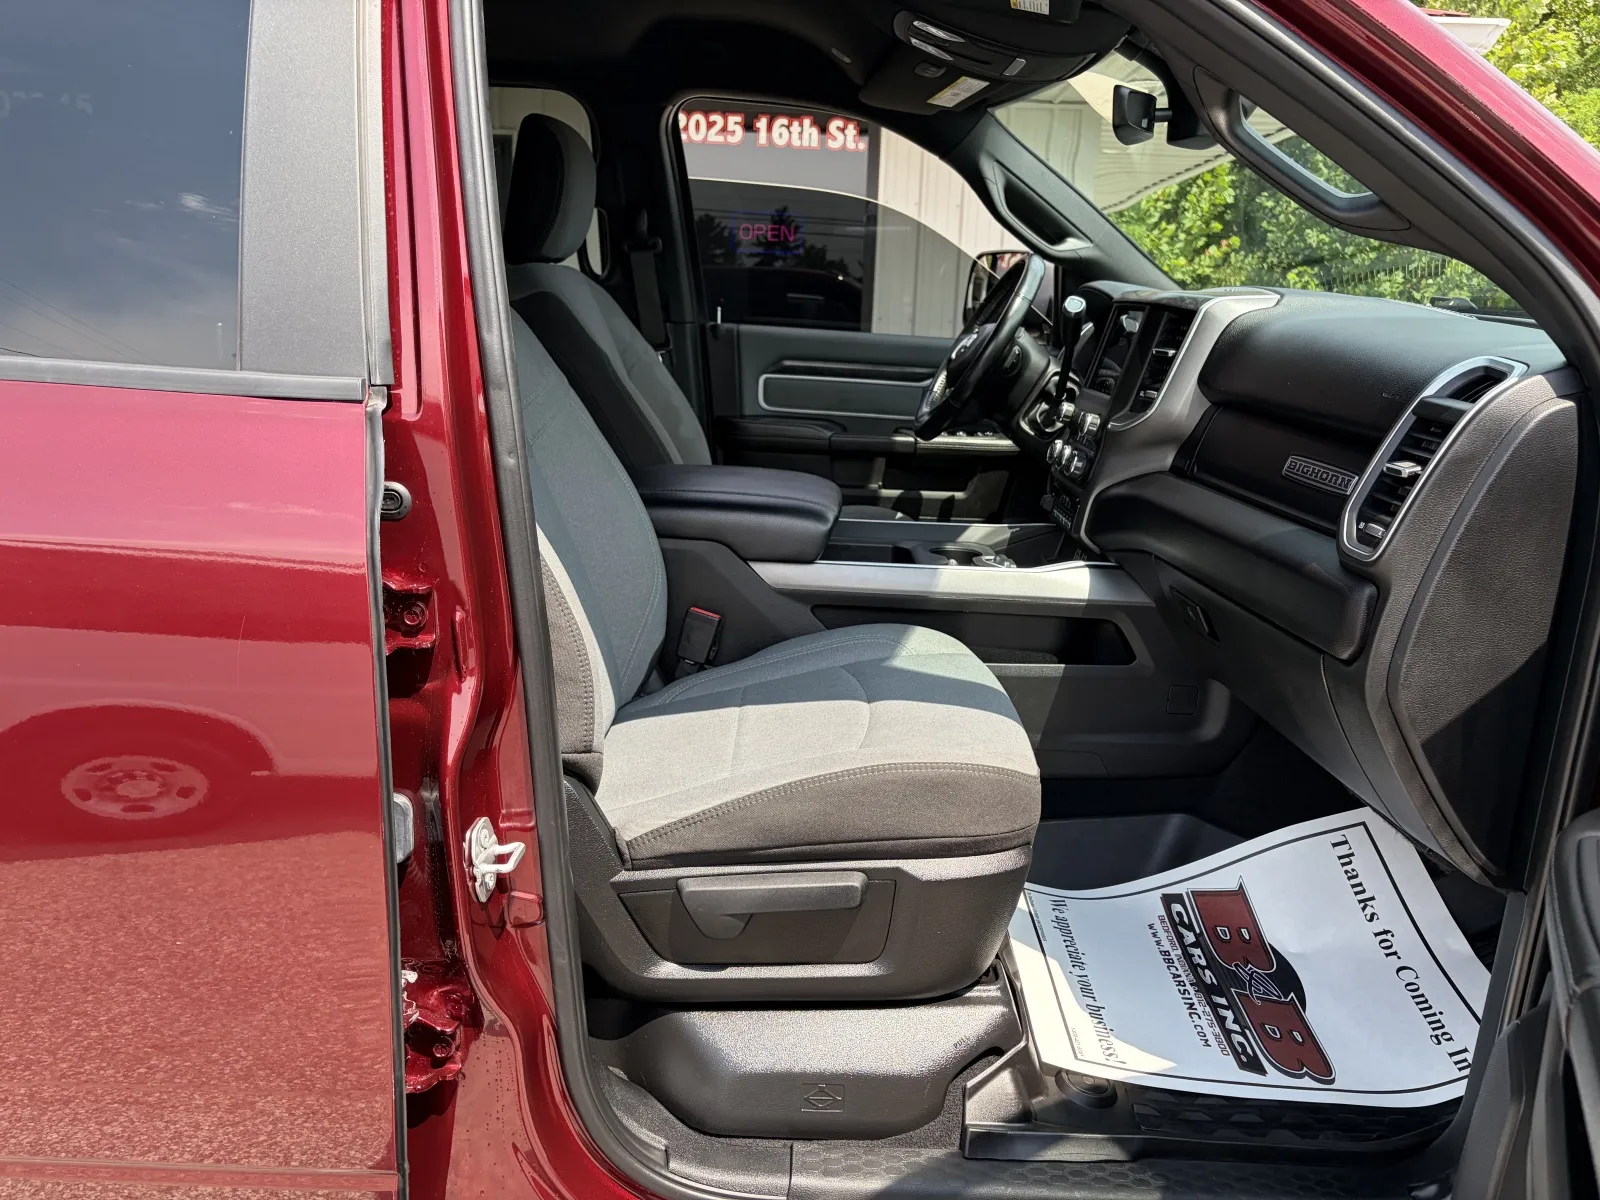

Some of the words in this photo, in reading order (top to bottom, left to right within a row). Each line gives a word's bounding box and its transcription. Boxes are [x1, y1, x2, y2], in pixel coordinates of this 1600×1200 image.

[679, 110, 745, 144] 2025
[753, 112, 820, 149] 16th
[825, 117, 868, 151] St.
[739, 224, 795, 242] OPEN
[1286, 459, 1354, 489] BIGHORN
[1048, 899, 1070, 914] We
[1050, 914, 1088, 971] appreciate
[1330, 834, 1380, 923] Thanks
[1372, 928, 1402, 960] for
[1395, 965, 1455, 1046] Coming
[1069, 970, 1098, 1003] your
[1170, 903, 1218, 987] CARS
[1211, 994, 1254, 1063] INC.
[1085, 1002, 1127, 1065] business!
